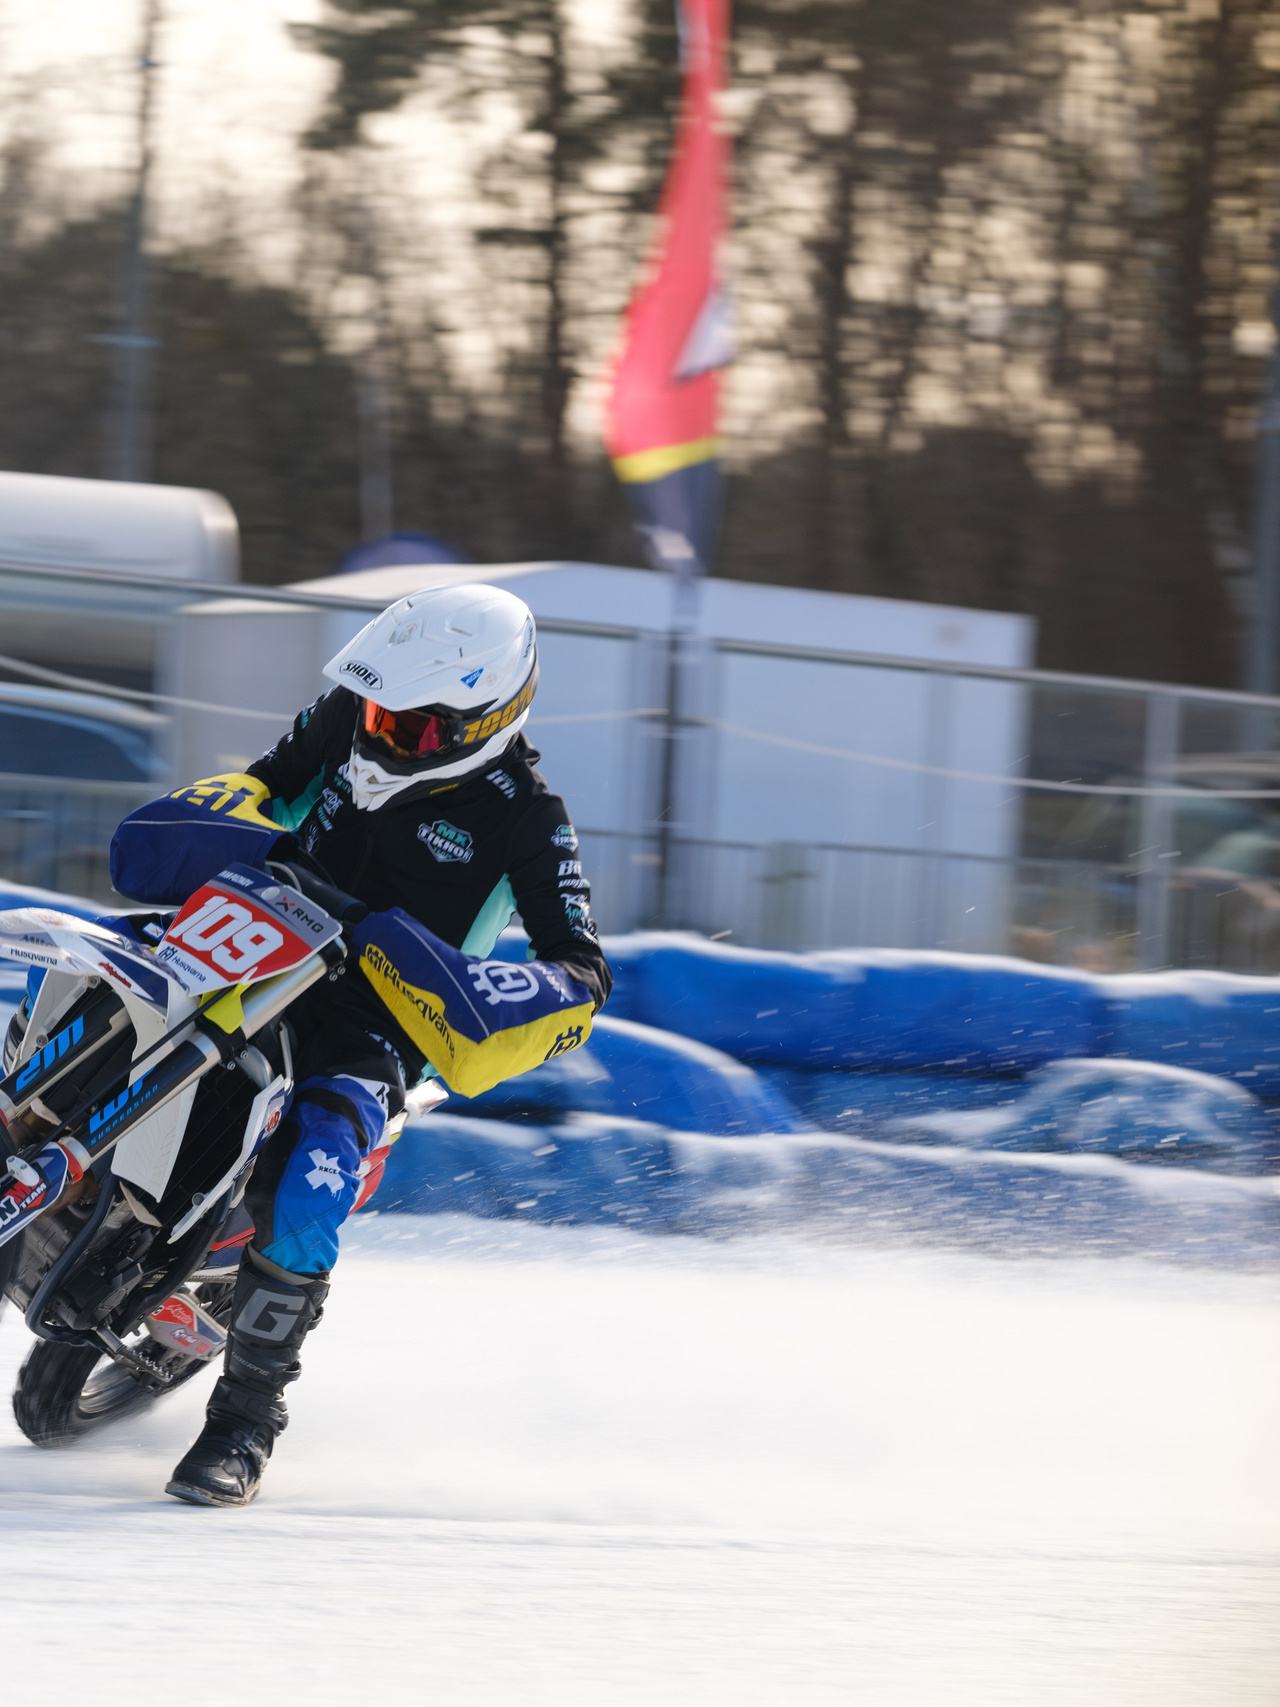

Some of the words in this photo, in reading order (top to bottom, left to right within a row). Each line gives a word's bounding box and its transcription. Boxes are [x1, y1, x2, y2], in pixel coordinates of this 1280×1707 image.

[344, 662, 380, 687] SHOEI
[462, 681, 535, 745] 100%
[419, 828, 471, 861] TIKHON
[436, 823, 468, 847] MX
[291, 906, 324, 934] RMG
[168, 895, 285, 975] 109
[9, 947, 59, 967] Husqvarna
[172, 954, 208, 984] Husqvarna
[19, 1182, 48, 1210] TEAM
